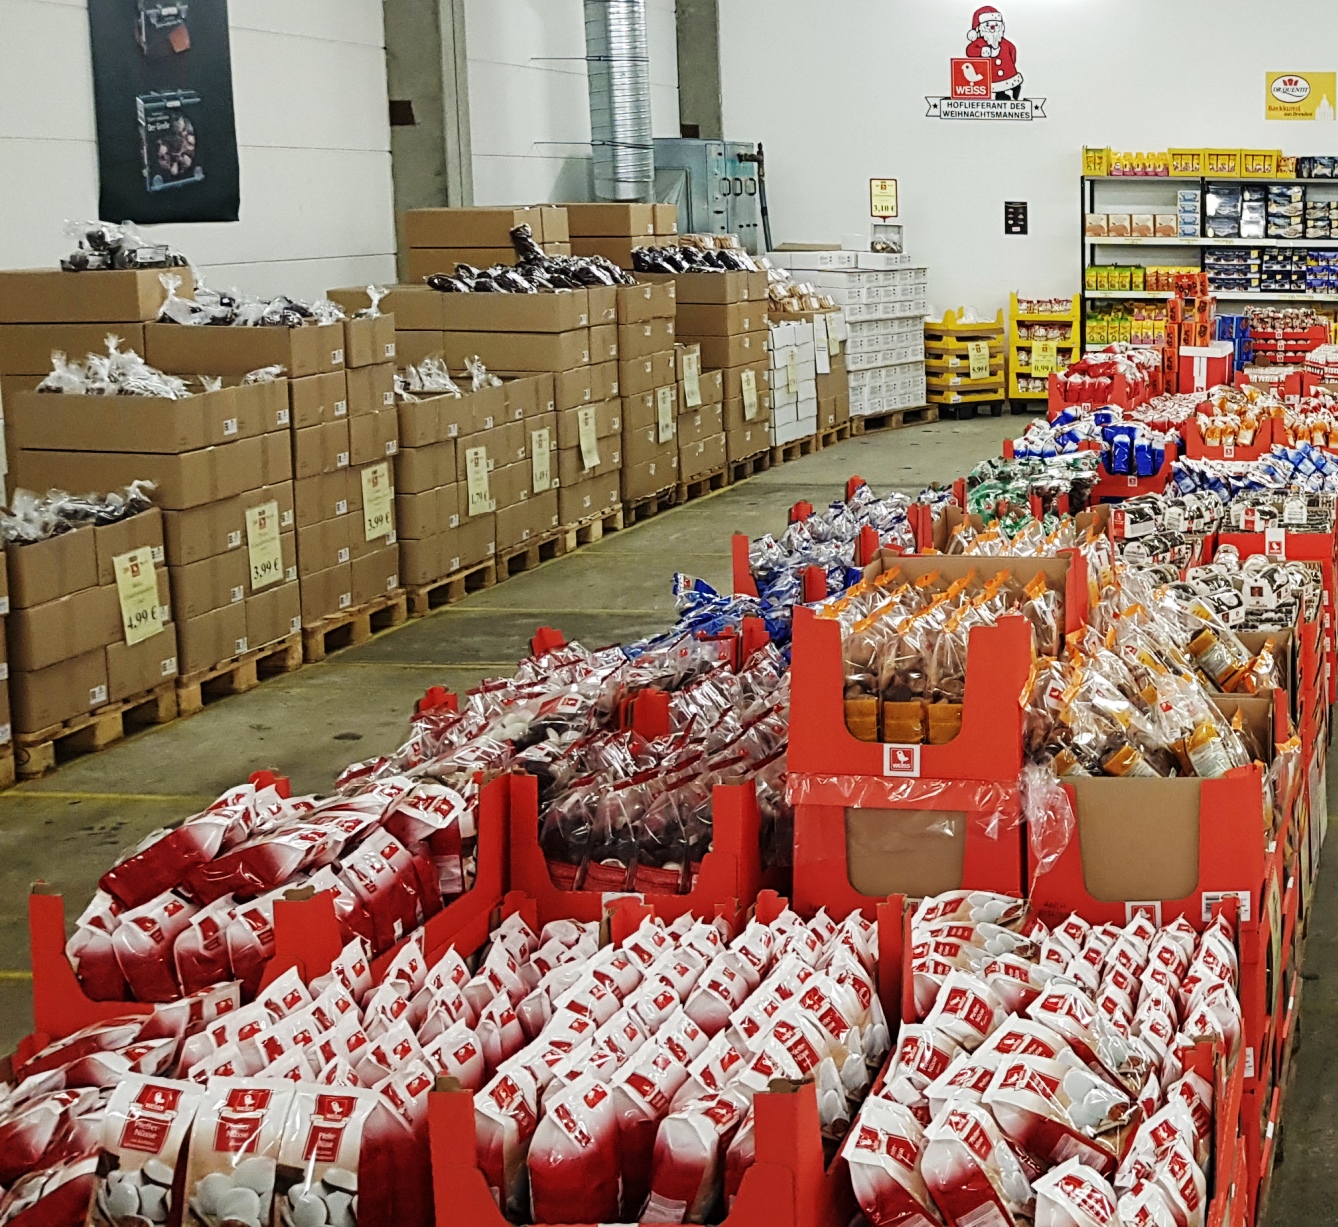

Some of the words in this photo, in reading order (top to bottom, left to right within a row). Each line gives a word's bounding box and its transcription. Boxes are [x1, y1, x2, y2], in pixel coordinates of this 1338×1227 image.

[955, 85, 987, 95] WEISS
[946, 101, 1007, 110] HOFLIEFERANT
[1010, 102, 1026, 110] DES
[942, 110, 1031, 119] WEIHNACHTSMANNES
[873, 204, 889, 213] 3,10
[367, 514, 384, 532] 3,99
[254, 560, 272, 580] 3,99
[273, 558, 279, 571] €
[151, 606, 157, 620] €
